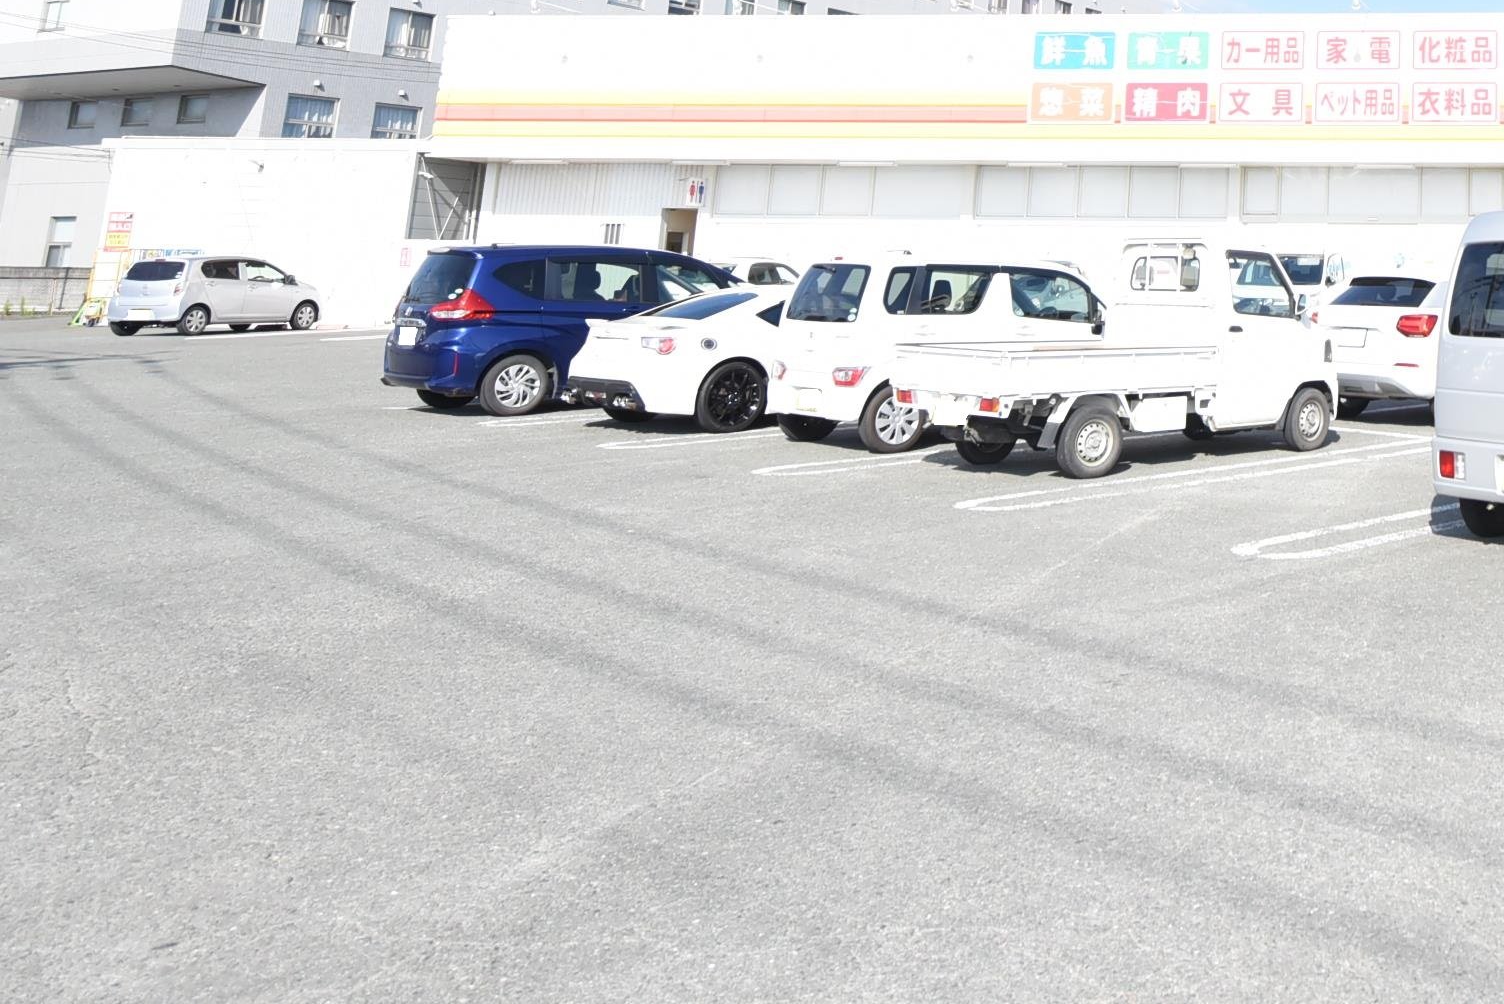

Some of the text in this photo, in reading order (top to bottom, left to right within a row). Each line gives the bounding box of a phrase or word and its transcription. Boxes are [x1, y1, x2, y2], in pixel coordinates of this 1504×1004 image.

[1226, 37, 1299, 63] カー用品
[1326, 36, 1391, 64] 家電
[1418, 36, 1492, 64] 化粧品
[1132, 87, 1201, 117] 精肉
[1228, 88, 1293, 116] 文具
[1321, 88, 1395, 116] ペット用品
[1418, 88, 1492, 116] 衣料品
